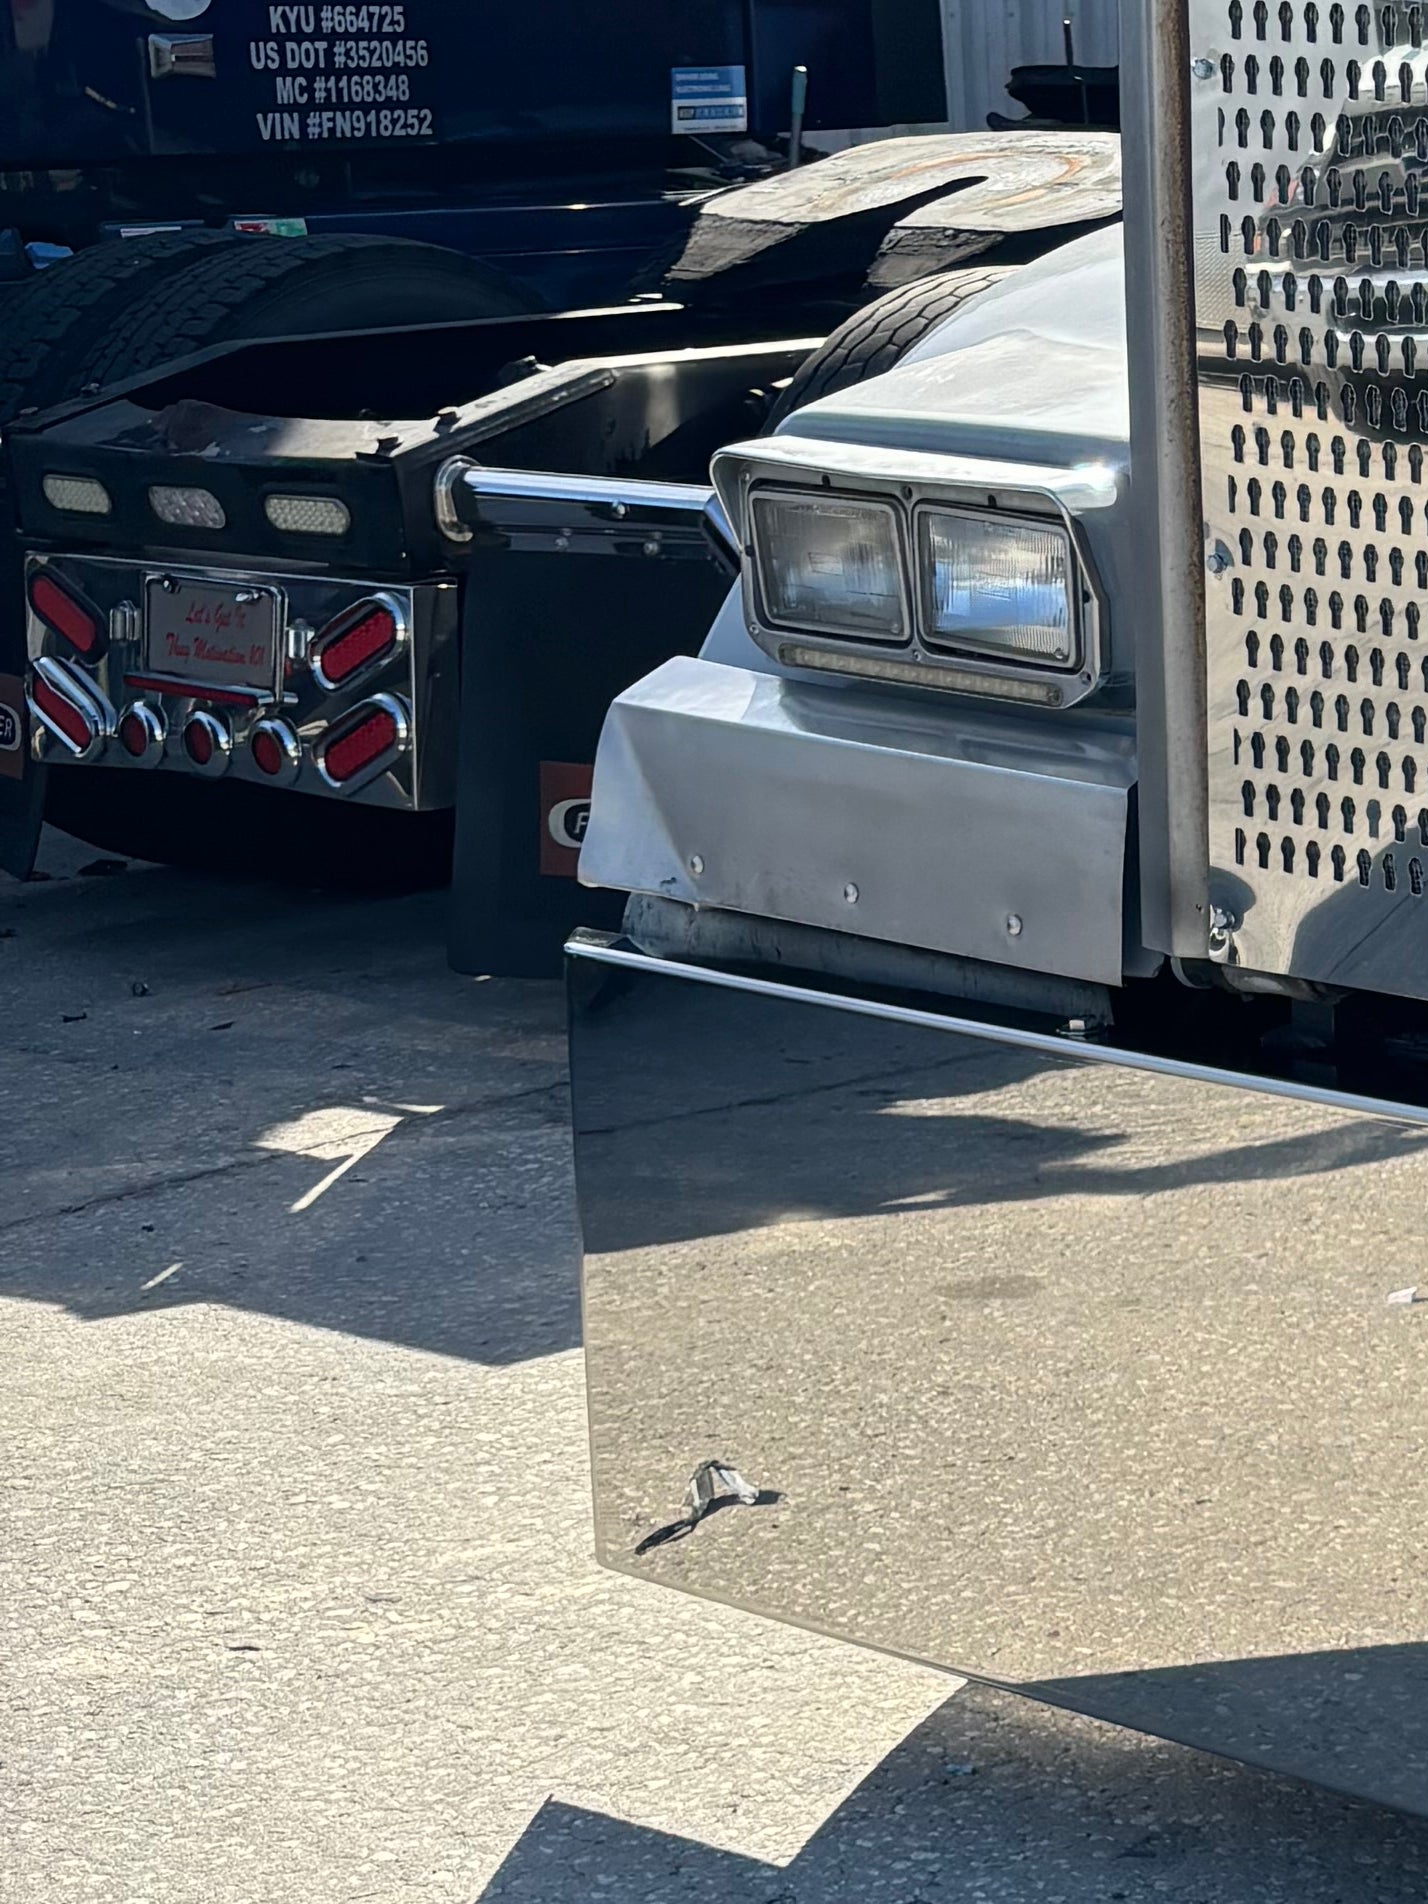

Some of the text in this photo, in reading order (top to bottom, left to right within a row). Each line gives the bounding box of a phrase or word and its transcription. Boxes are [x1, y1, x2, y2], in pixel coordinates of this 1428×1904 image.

[268, 4, 405, 34] KYU #664725
[249, 39, 429, 70] US DOT #3520456
[276, 74, 410, 105] MC #1168348
[256, 108, 433, 140] VIN #FN918252
